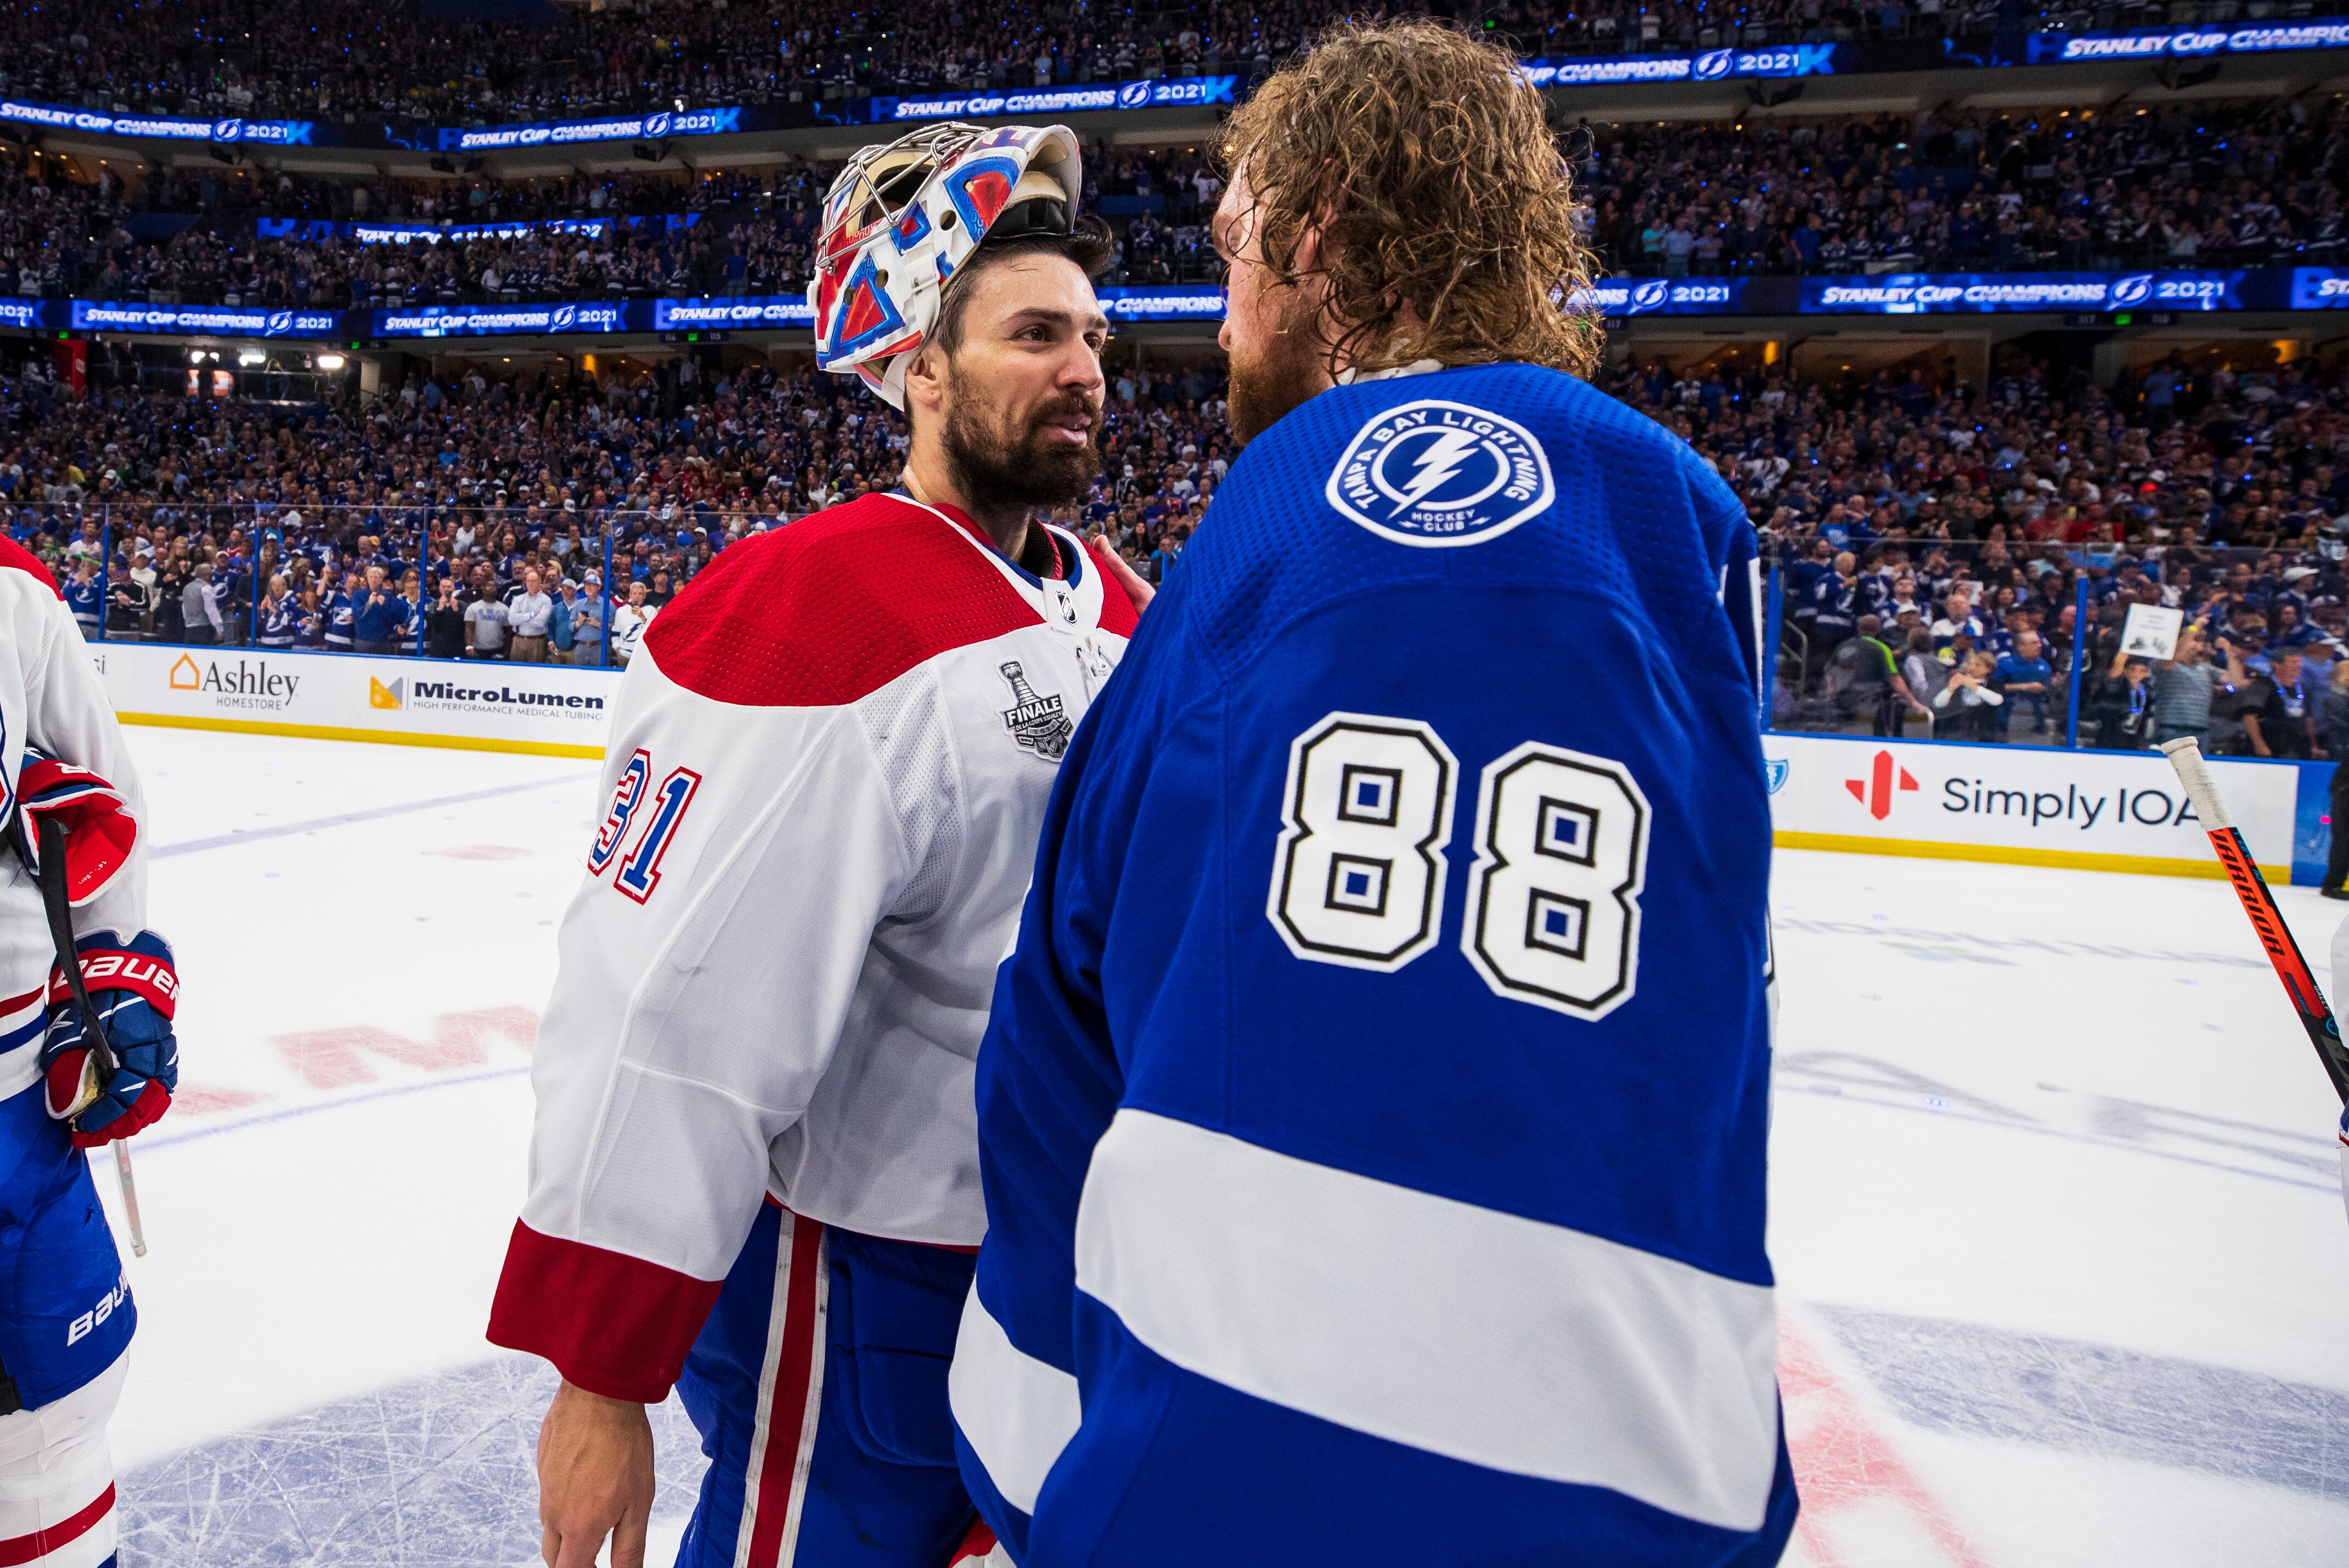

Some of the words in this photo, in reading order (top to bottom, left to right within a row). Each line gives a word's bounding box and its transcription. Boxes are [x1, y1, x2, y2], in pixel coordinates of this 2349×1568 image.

[2064, 35, 2173, 58] STANLEY
[2171, 32, 2228, 52] CUP
[1558, 59, 1691, 81] CHAMPIONS
[1739, 53, 1799, 71] 2021
[895, 100, 968, 117] STANLEY
[967, 98, 1005, 113] CUP
[1006, 91, 1116, 110] CHAMPIONS
[1156, 84, 1206, 100] 2021
[1, 103, 76, 123] STANLEY
[75, 114, 113, 128] CUP
[114, 120, 211, 137] CHAMPIONS
[245, 125, 288, 138] 2021
[461, 131, 521, 147] STANLEY
[520, 128, 551, 143] CUP
[551, 121, 641, 140] CHAMPIONS
[674, 115, 716, 130] 2021
[1115, 296, 1223, 313] CHAMPIONS
[1672, 286, 1730, 302] 2021
[1822, 286, 1915, 303] STANLEY
[1915, 285, 1963, 302] CUP
[1964, 284, 2107, 302] CHAMPIONS
[2159, 281, 2226, 298] 2021
[86, 308, 147, 323] STANLEY
[145, 311, 177, 324] CUP
[177, 313, 265, 329] CHAMPIONS
[296, 317, 332, 329] 2021
[385, 317, 440, 330] STANLEY
[439, 315, 467, 328] CUP
[467, 313, 549, 328] CHAMPIONS
[578, 310, 617, 323] 2021
[669, 307, 731, 321] STANLEY
[730, 306, 763, 319] CUP
[1343, 448, 1379, 509] TAMPA
[1372, 410, 1428, 443] BAY
[1442, 411, 1537, 501] LIGHTNING
[1411, 509, 1476, 522] HOCKEY
[1423, 521, 1466, 533] CLUB
[202, 659, 300, 706] Ashley
[415, 682, 604, 709] MicroLumen
[216, 696, 282, 711] HOMESTORE
[414, 701, 438, 710] HIGH
[442, 702, 514, 715] PERFORMANCE
[516, 708, 561, 718] MEDICAL
[565, 711, 603, 721] TUBING
[1006, 697, 1062, 726] FINALE
[1029, 717, 1044, 726] COUPE
[1044, 711, 1062, 722] STANLEY
[1942, 777, 2107, 830] Simply
[588, 748, 703, 905] 31
[1266, 710, 1652, 1023] 88
